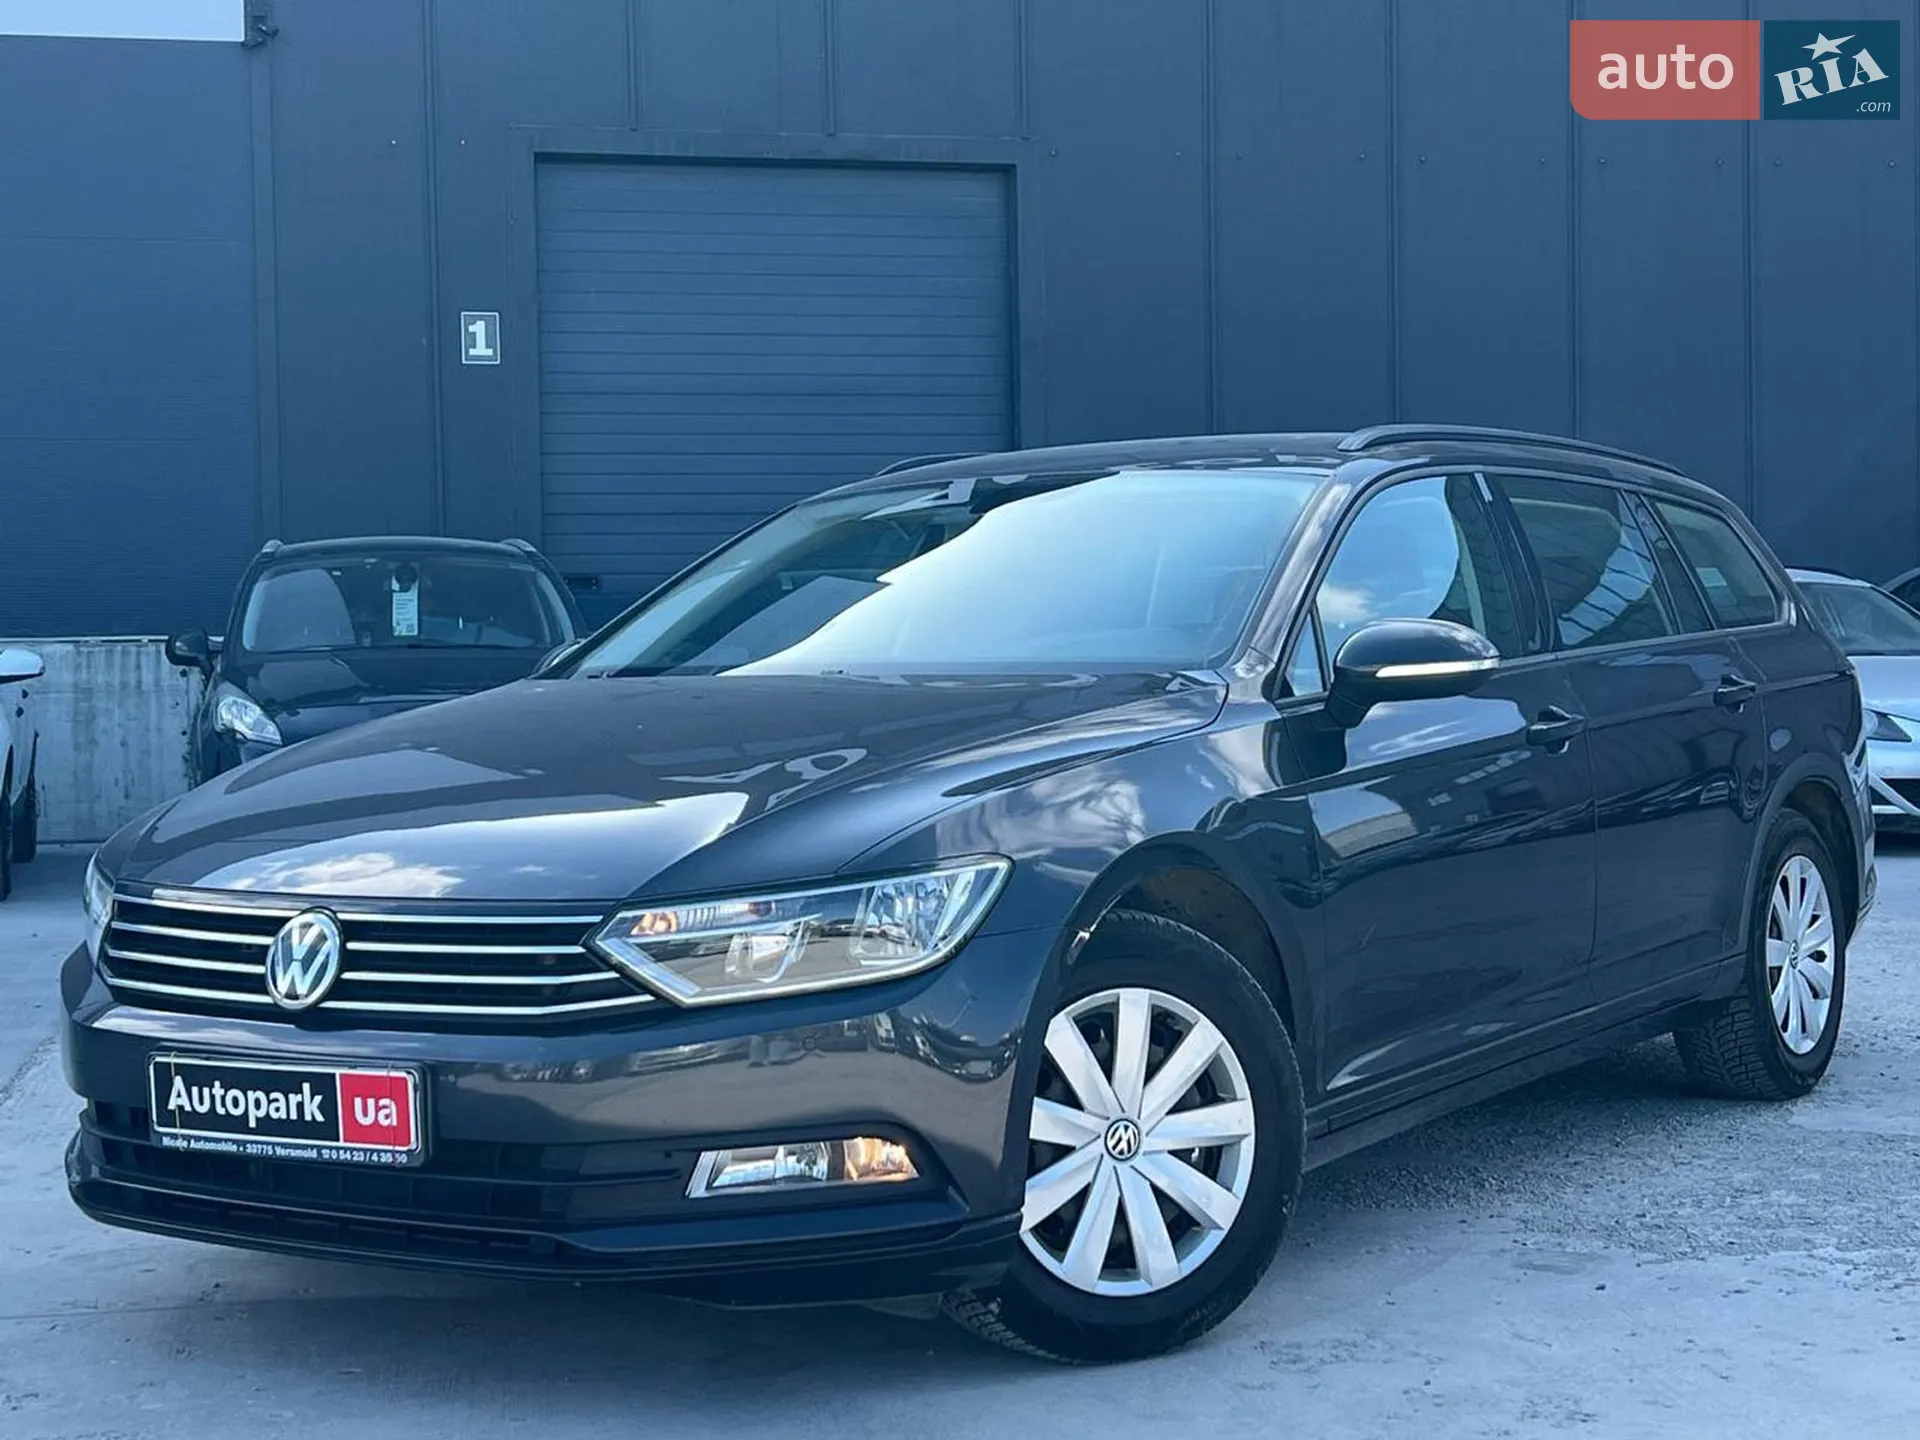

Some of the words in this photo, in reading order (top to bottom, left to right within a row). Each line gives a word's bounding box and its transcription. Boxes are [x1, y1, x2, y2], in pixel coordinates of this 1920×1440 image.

[468, 320, 493, 356] 1
[167, 1075, 325, 1128] Autopark
[353, 1096, 398, 1127] ua
